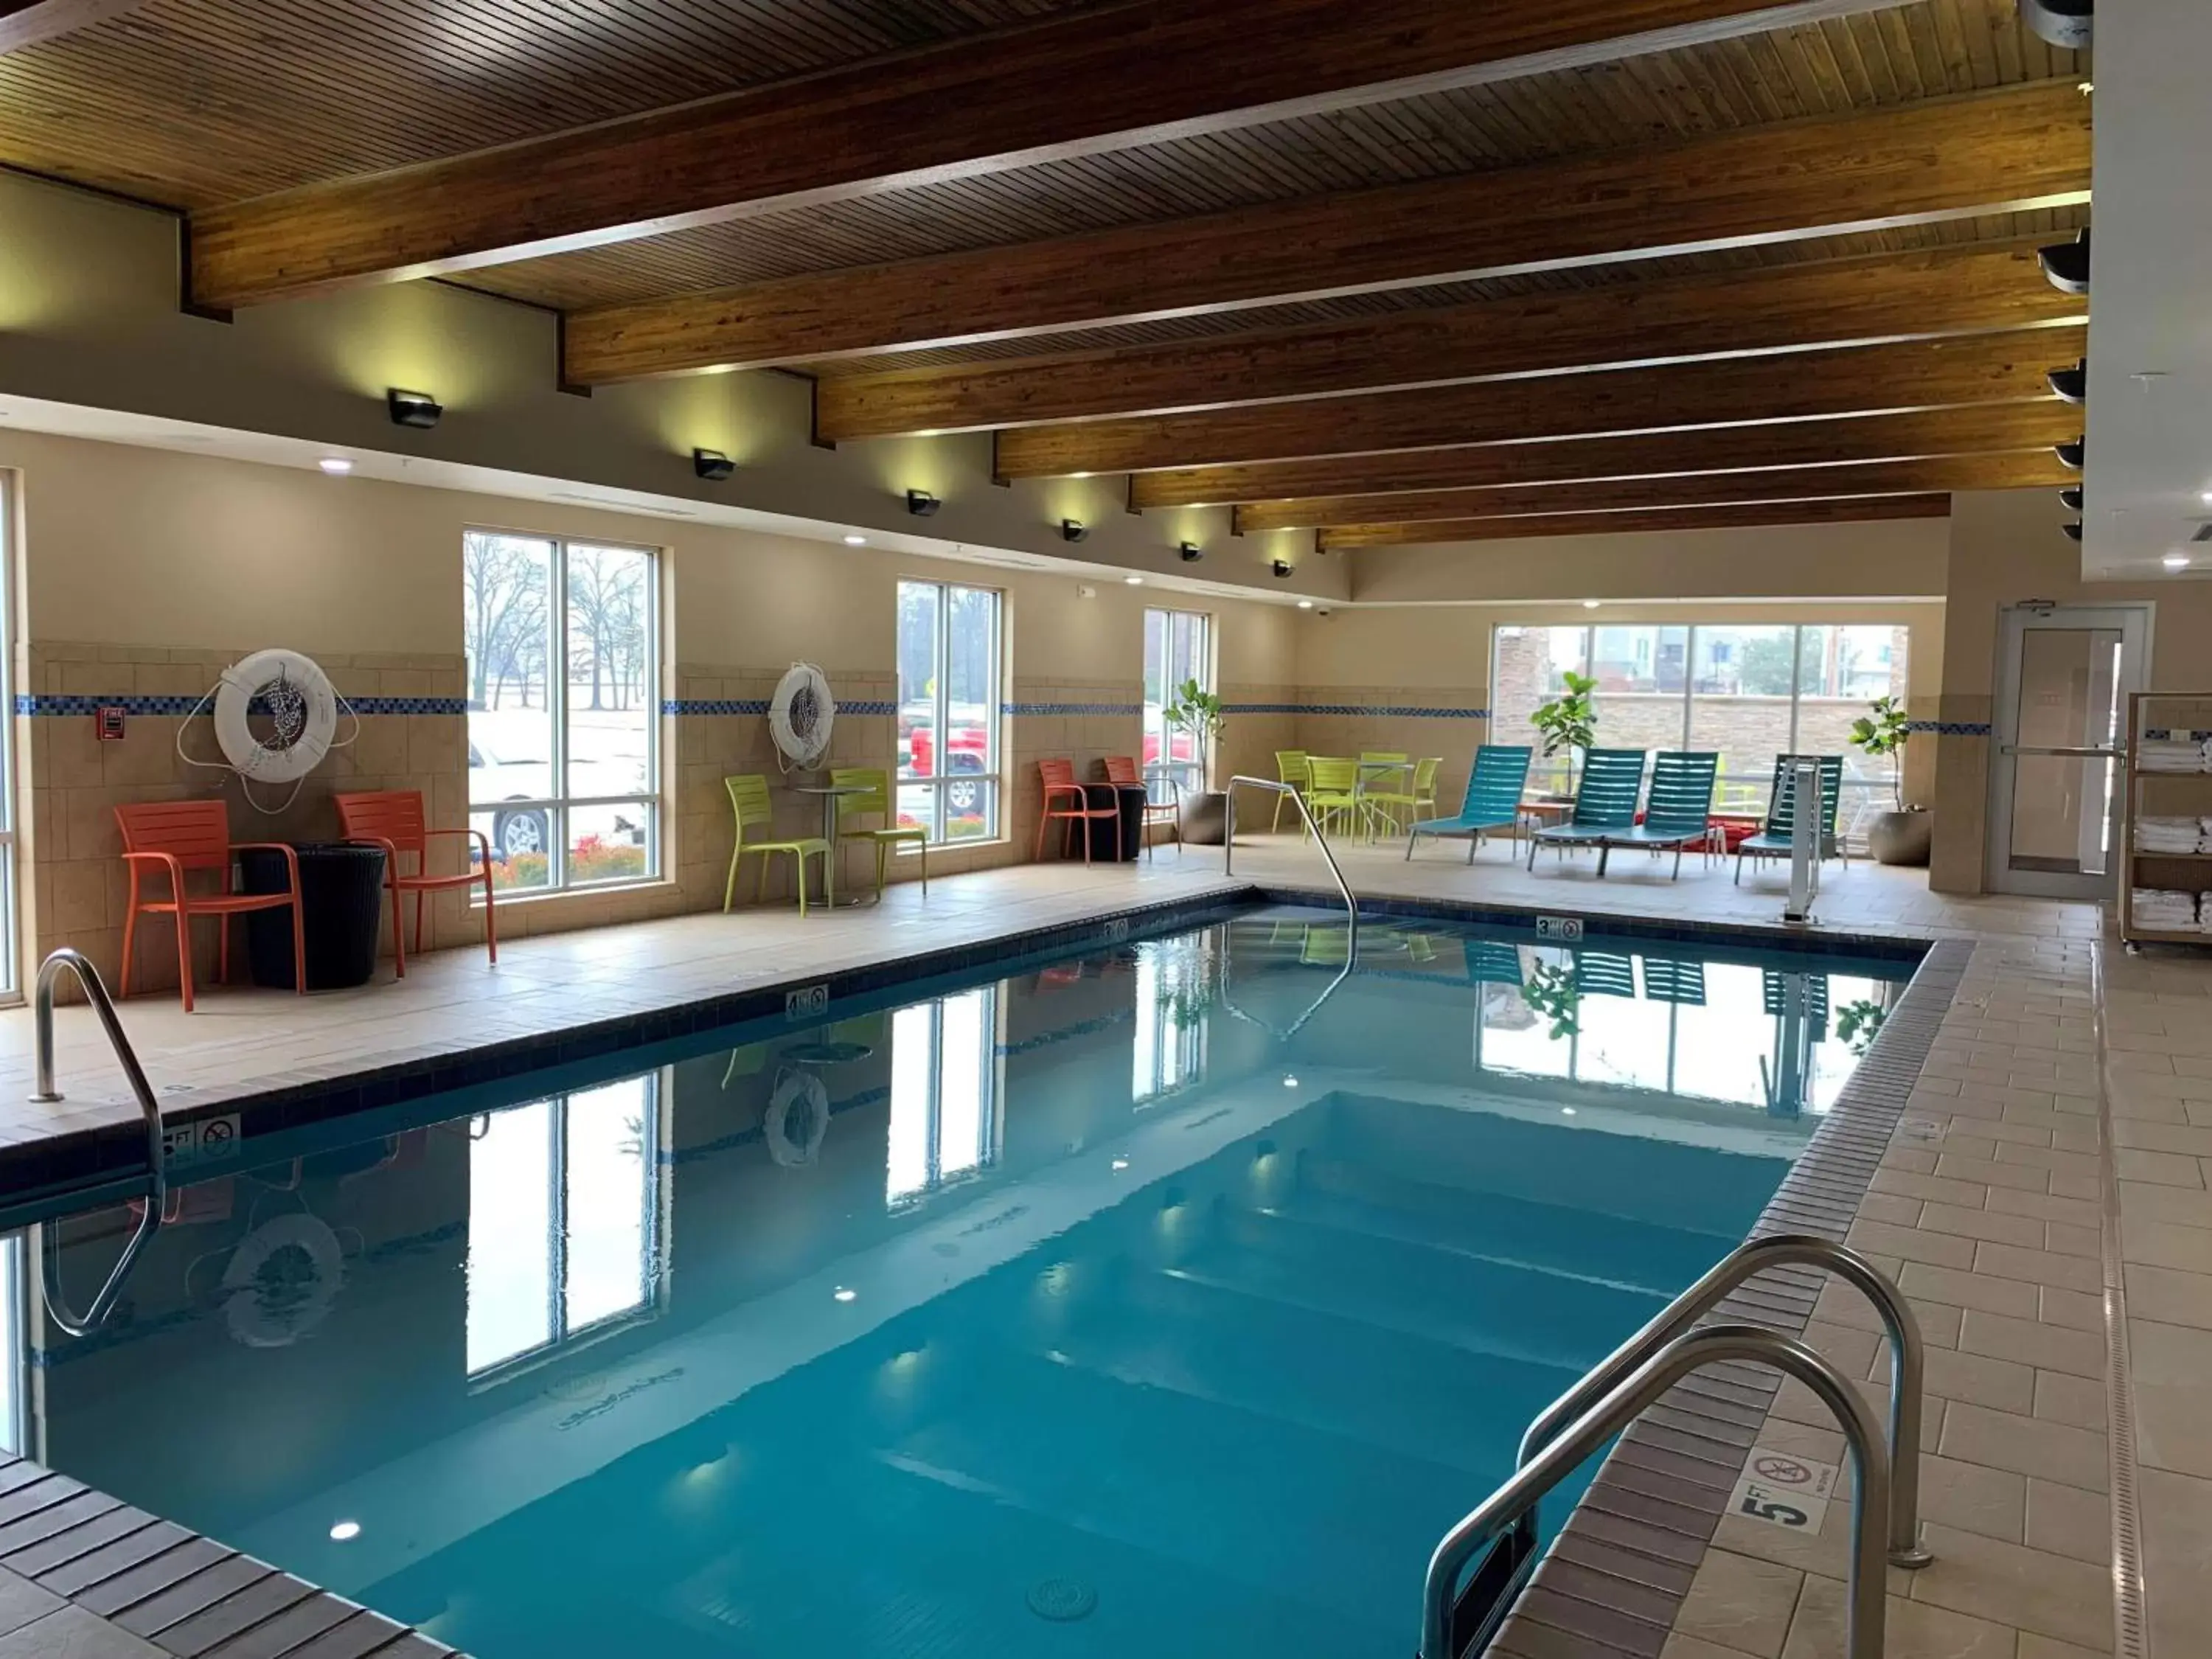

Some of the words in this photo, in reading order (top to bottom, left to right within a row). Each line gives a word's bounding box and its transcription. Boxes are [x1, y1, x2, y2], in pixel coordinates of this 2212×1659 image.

[1539, 919, 1548, 935] 3
[176, 1130, 191, 1146] FT
[1740, 1497, 1807, 1526] 5
